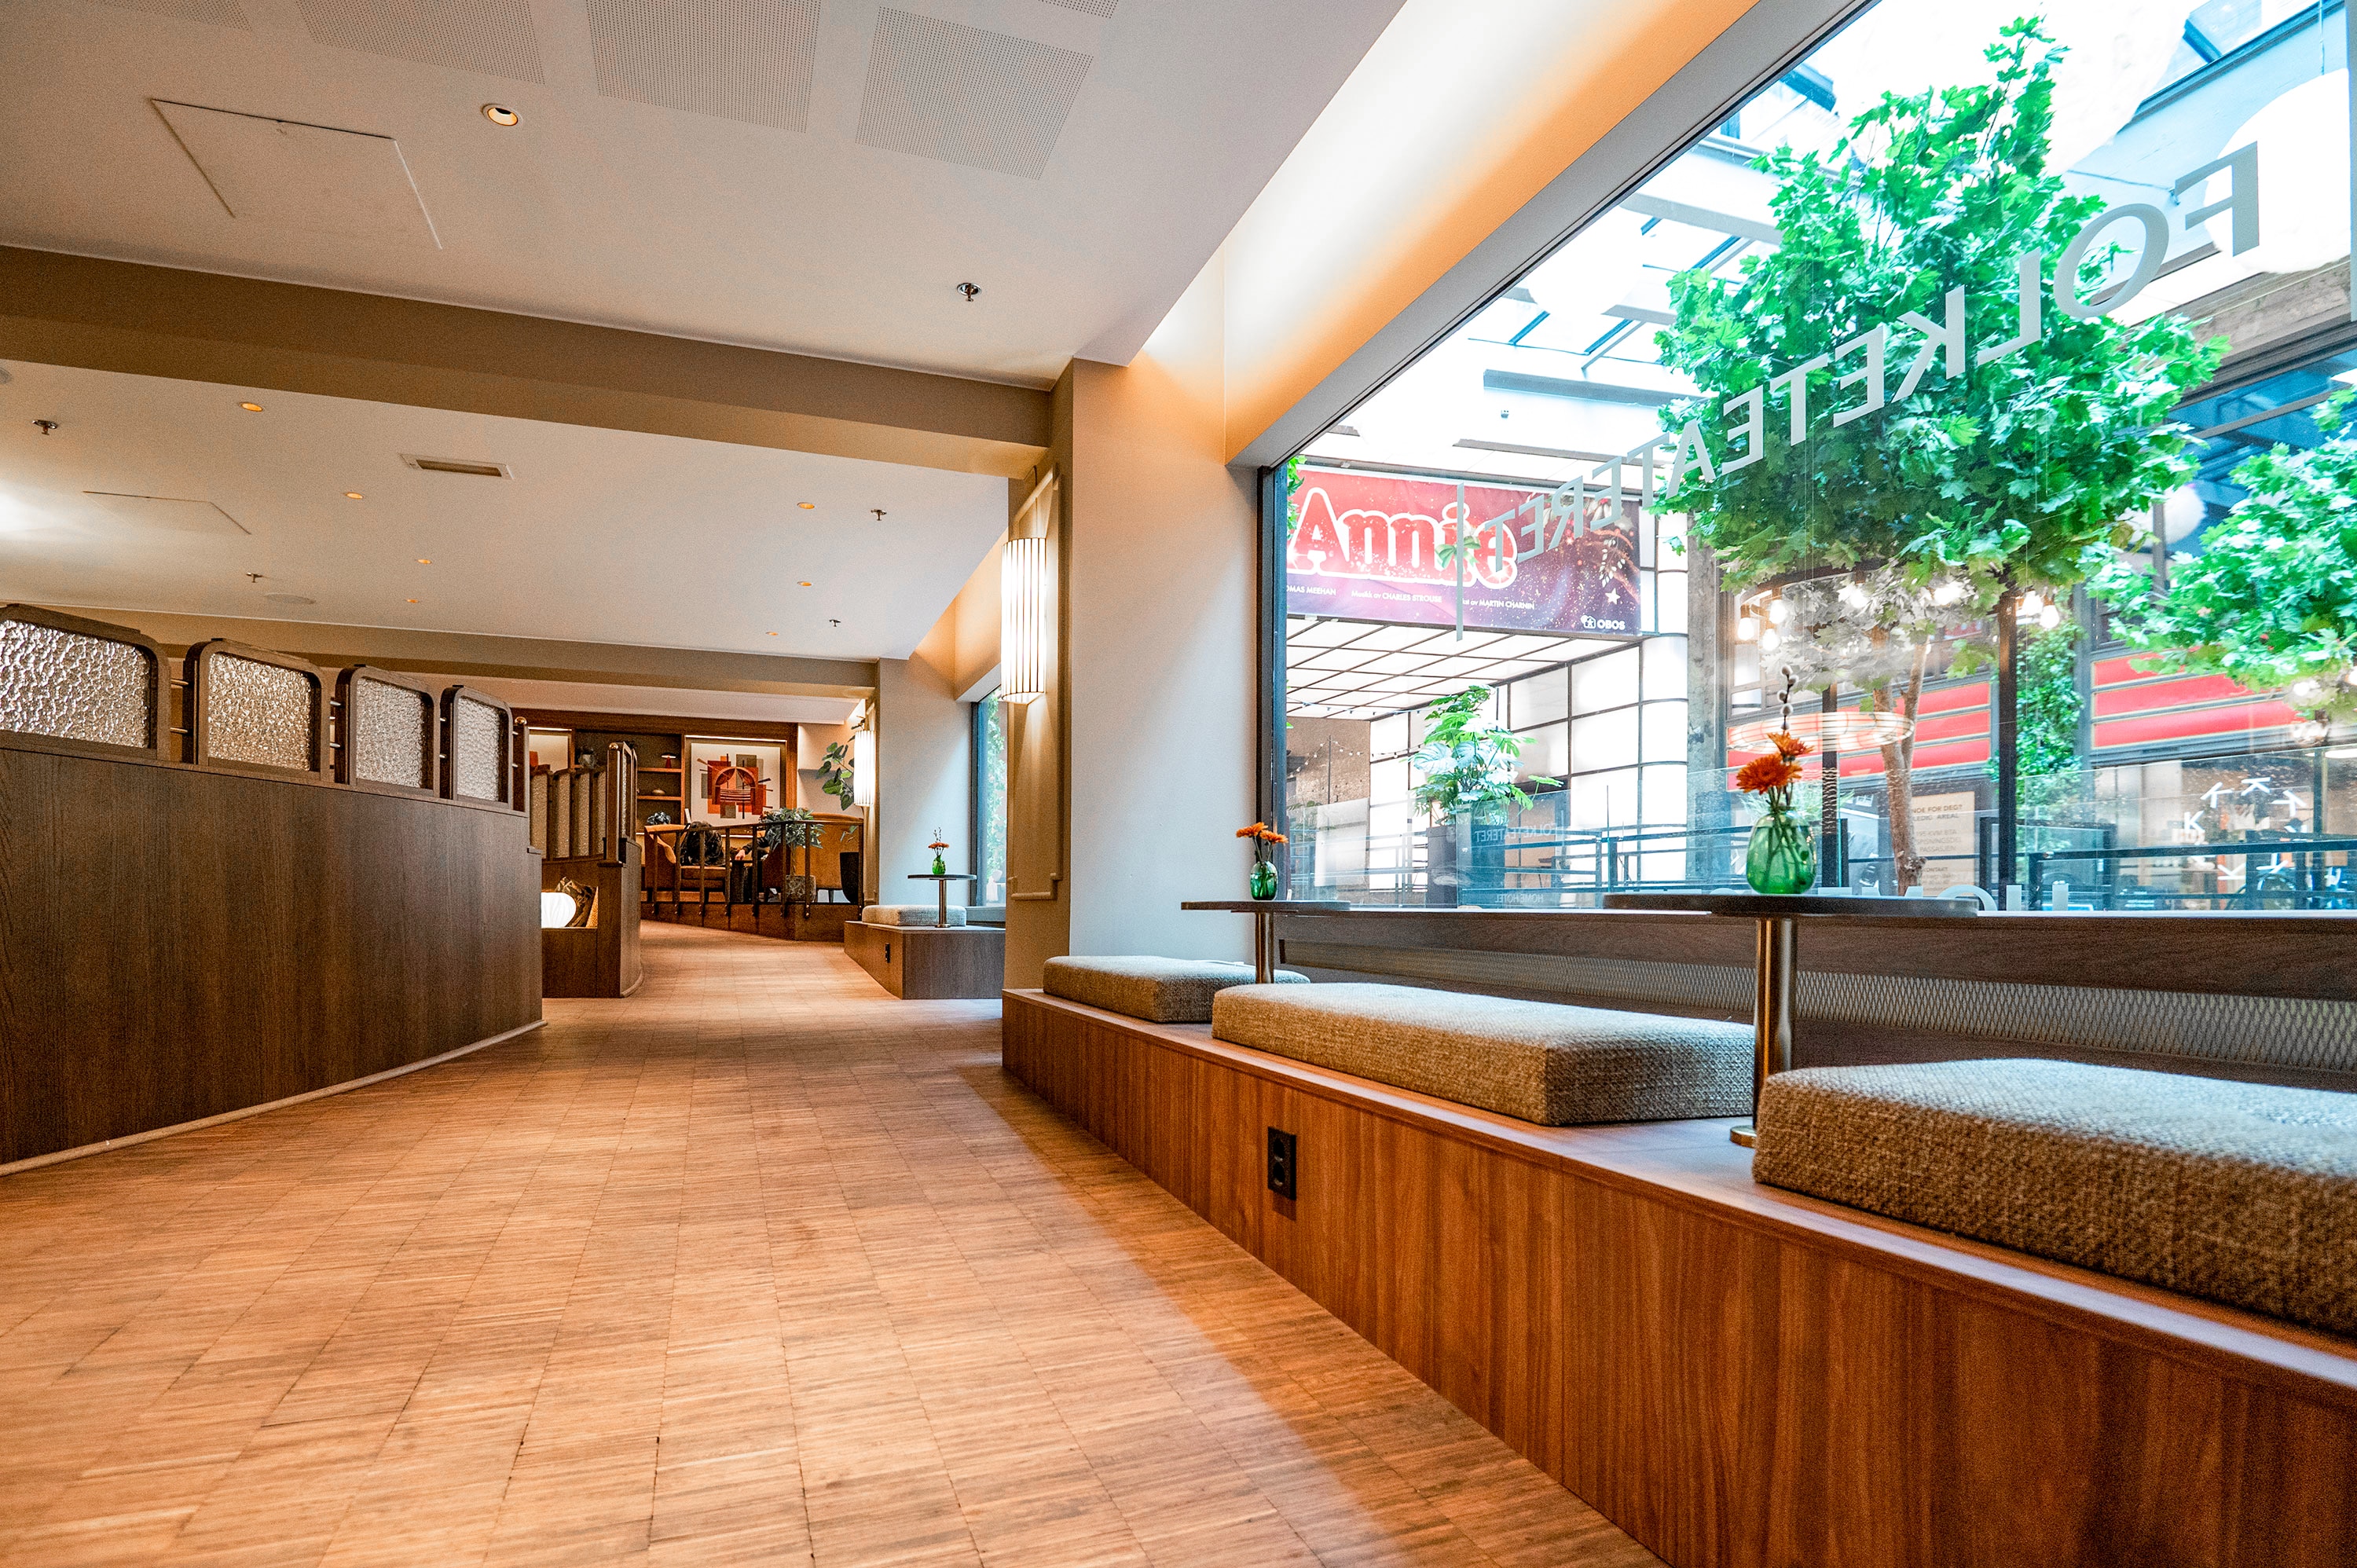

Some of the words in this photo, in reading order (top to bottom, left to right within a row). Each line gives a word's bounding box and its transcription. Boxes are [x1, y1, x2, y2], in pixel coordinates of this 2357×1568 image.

[1287, 487, 1518, 589] Annie
[1306, 586, 1336, 595] MEEHAN
[1351, 590, 1373, 599] Musikk
[1382, 592, 1411, 601] CHARLES
[1412, 594, 1442, 603] STROUSE
[1479, 599, 1505, 608] MARTIN
[1505, 600, 1535, 610] CHARNIN
[1597, 619, 1626, 630] OBOS
